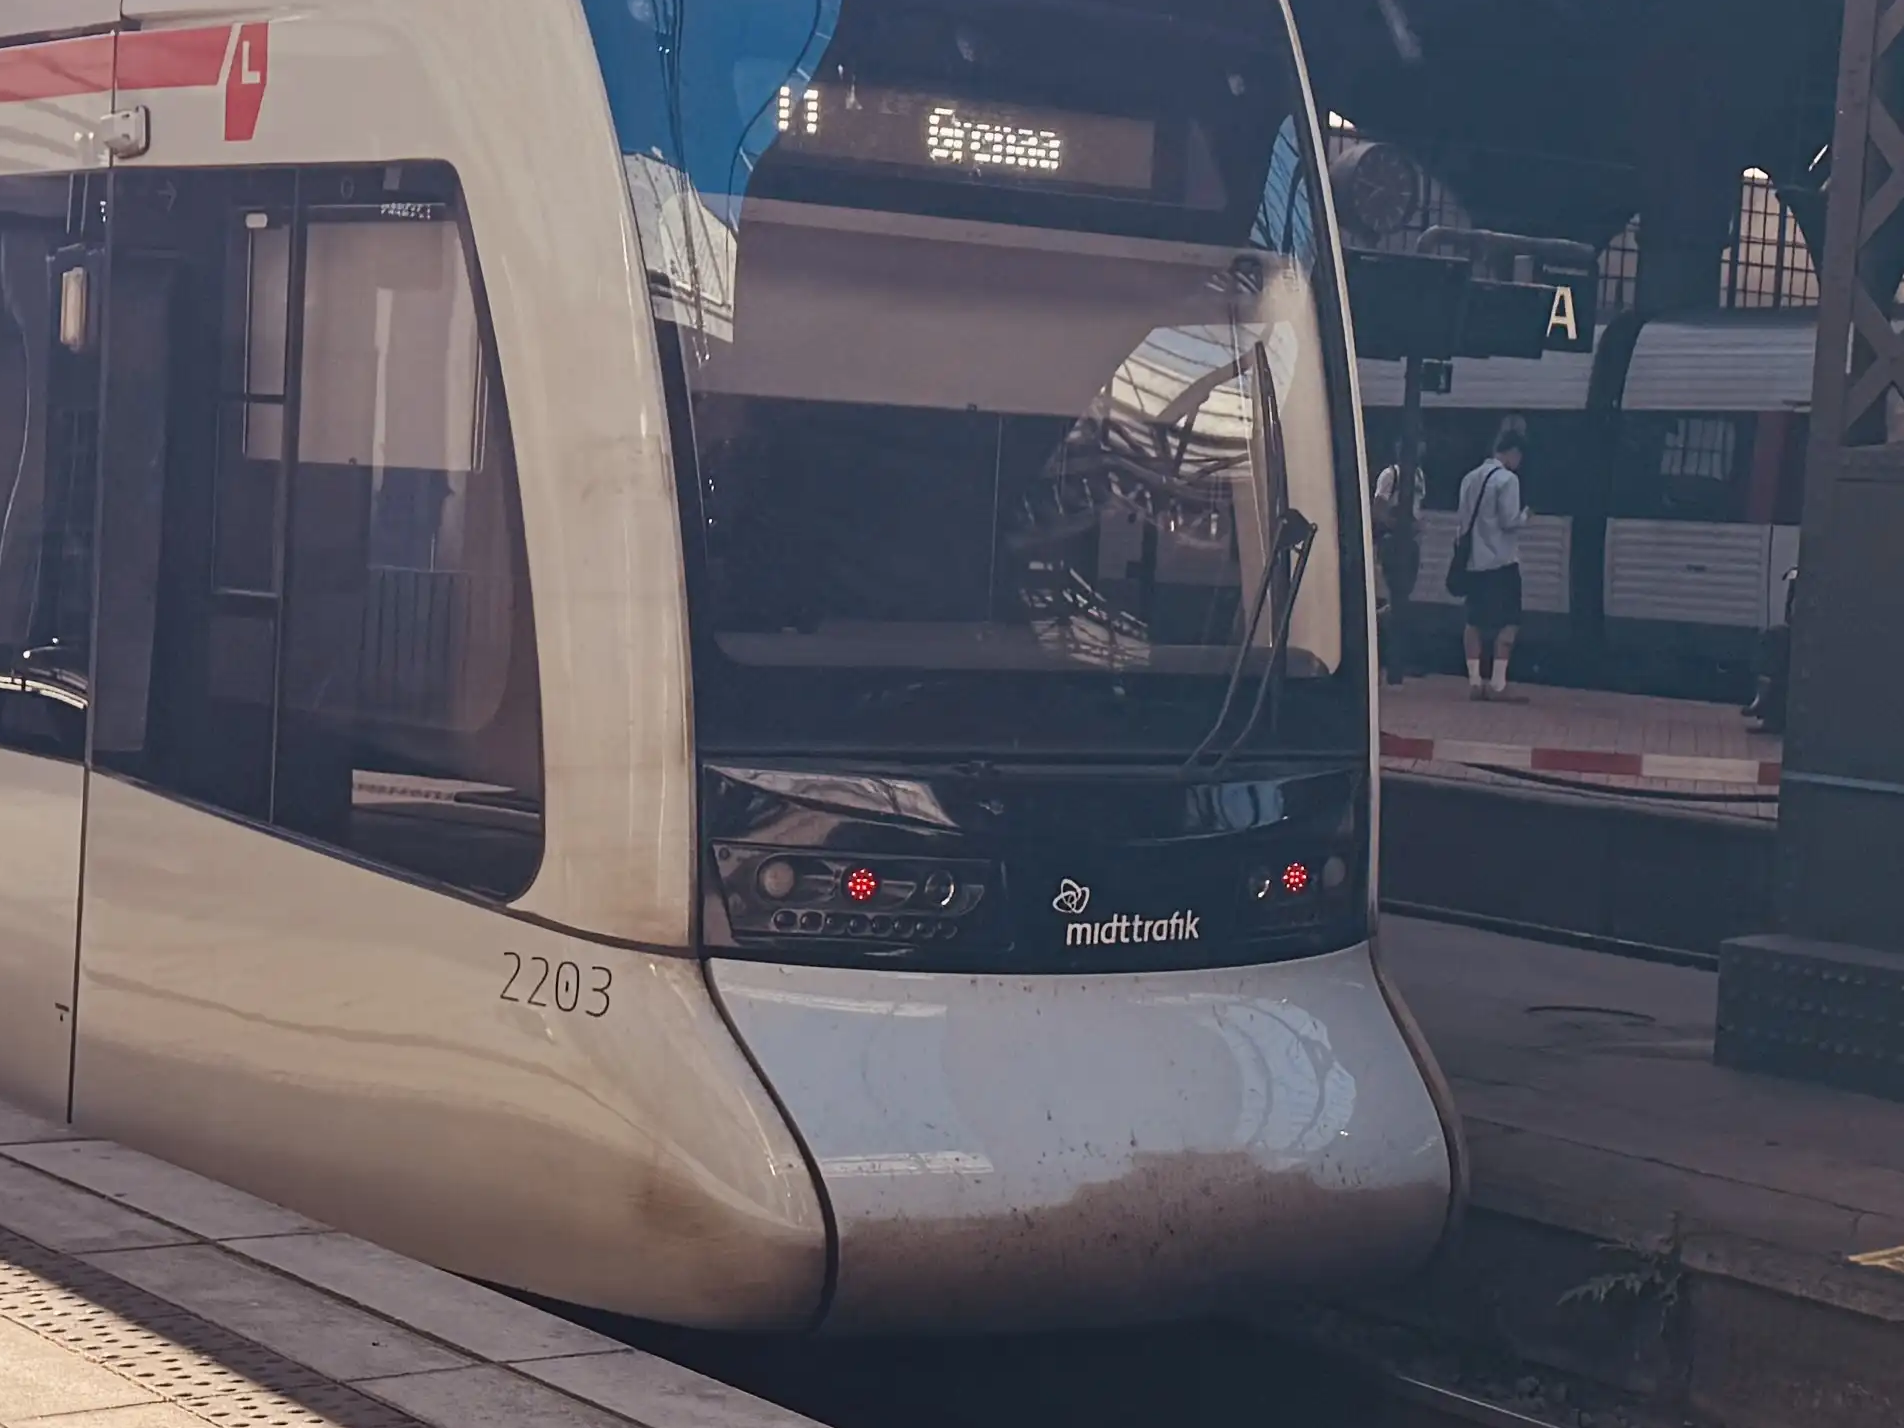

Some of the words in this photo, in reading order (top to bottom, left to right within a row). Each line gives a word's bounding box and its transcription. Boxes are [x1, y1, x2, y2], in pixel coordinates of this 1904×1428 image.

[1546, 286, 1578, 340] A
[1065, 909, 1201, 946] midttrafik
[499, 951, 613, 1018] 2203
